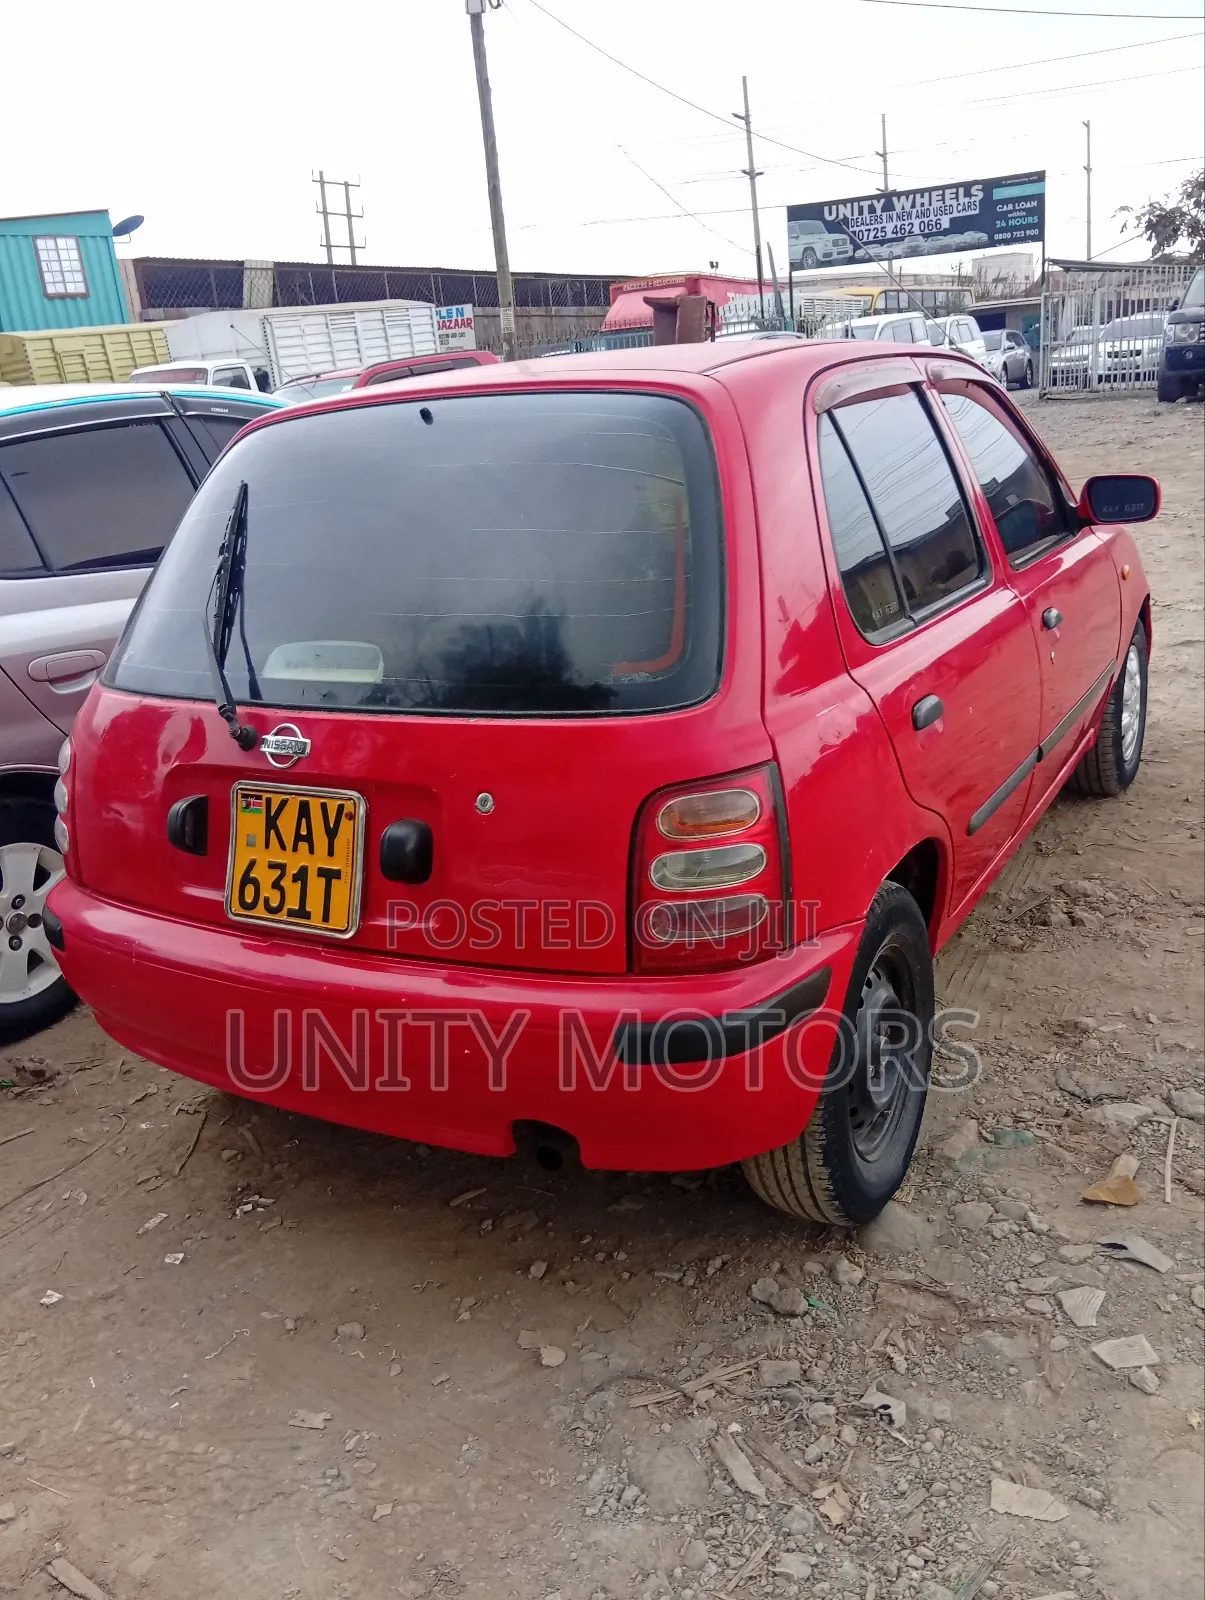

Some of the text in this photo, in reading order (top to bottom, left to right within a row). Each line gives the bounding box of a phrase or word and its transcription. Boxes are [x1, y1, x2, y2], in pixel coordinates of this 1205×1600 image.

[823, 184, 984, 221] UNITY WHEELS
[850, 200, 978, 229] DEALERS IN NEW AND USED CARS
[997, 201, 1037, 212] CAR LOAN
[857, 218, 943, 242] 0725 462 066
[996, 216, 1038, 228] 24 HOURS
[263, 738, 304, 752] NISSAN
[264, 796, 346, 857] KAY
[238, 857, 342, 923] 631T
